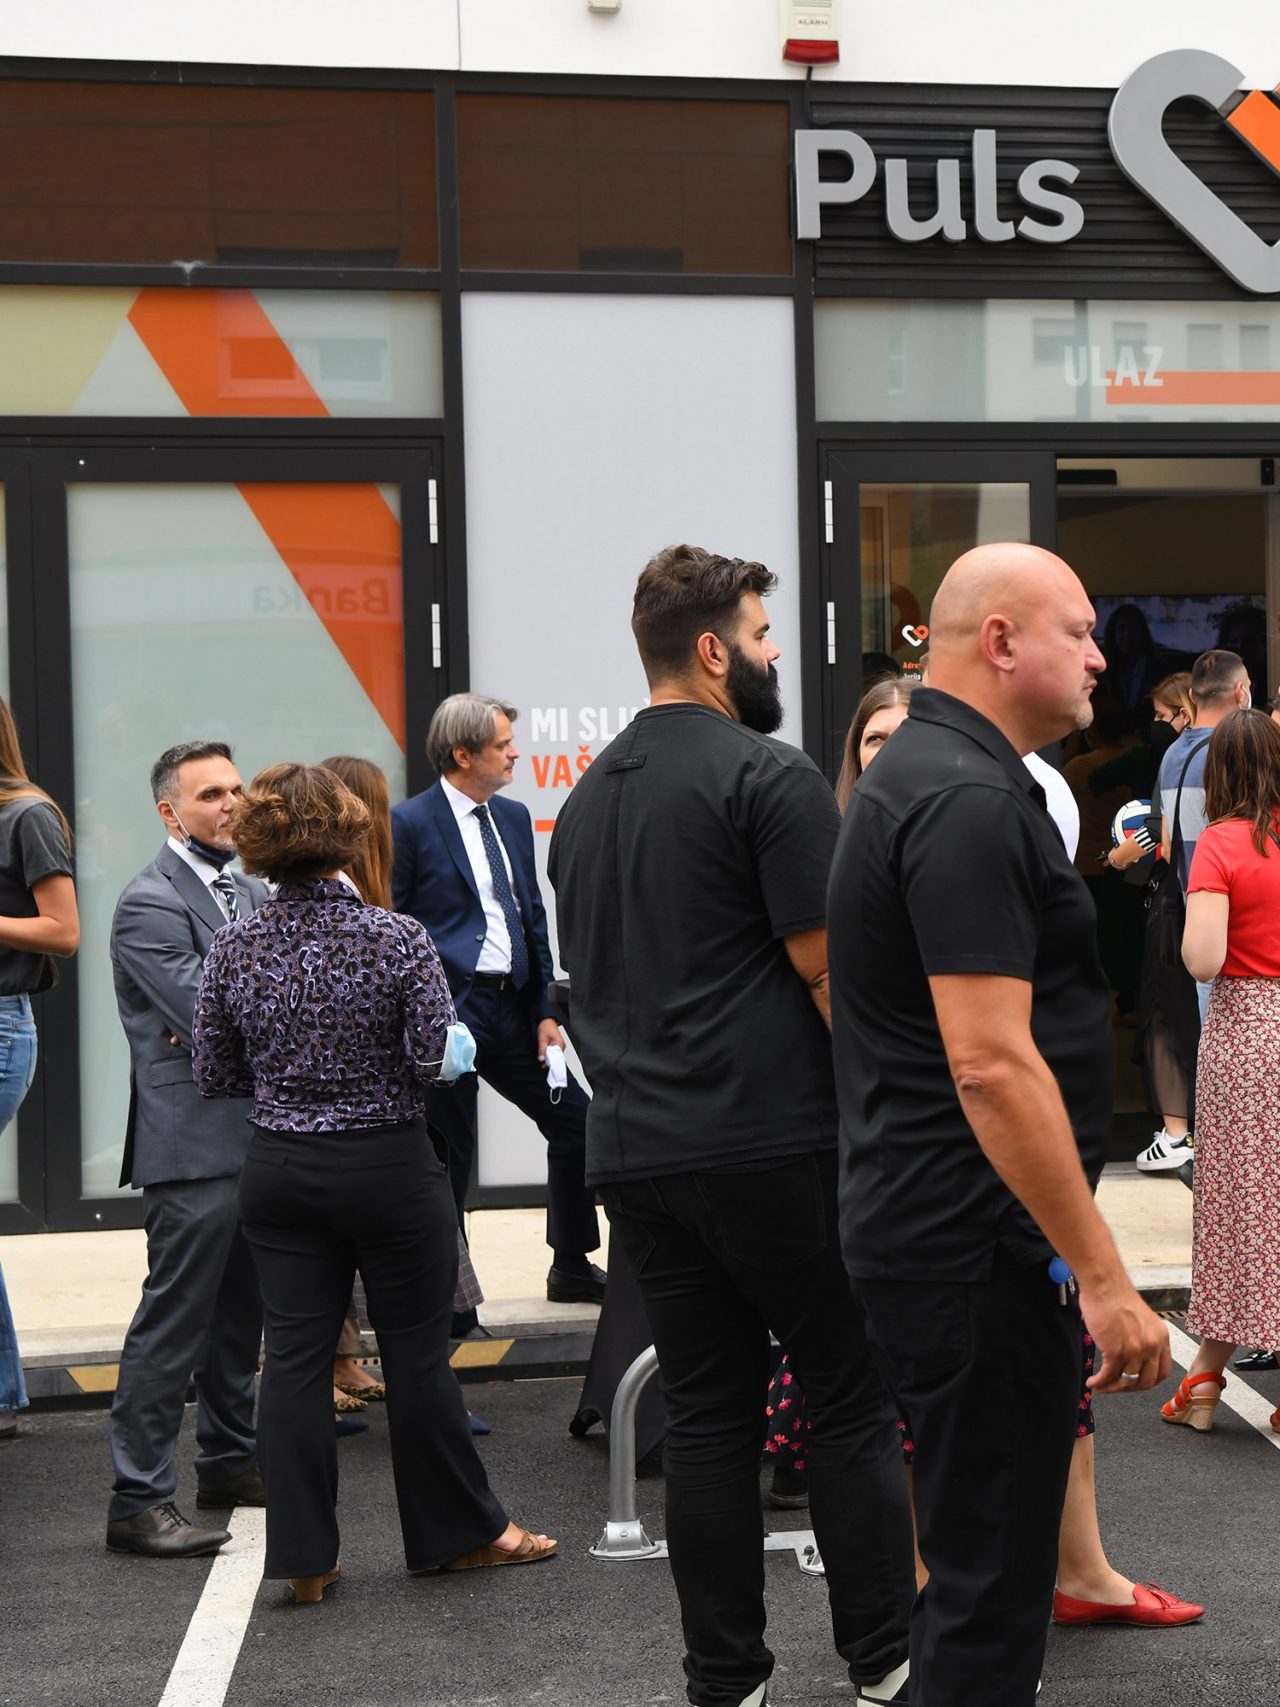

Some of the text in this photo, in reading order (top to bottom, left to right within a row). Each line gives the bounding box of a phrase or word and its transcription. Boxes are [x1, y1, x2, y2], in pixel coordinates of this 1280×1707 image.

[793, 128, 1086, 244] Puls
[1063, 345, 1165, 388] ULAZ
[531, 706, 570, 742] MI
